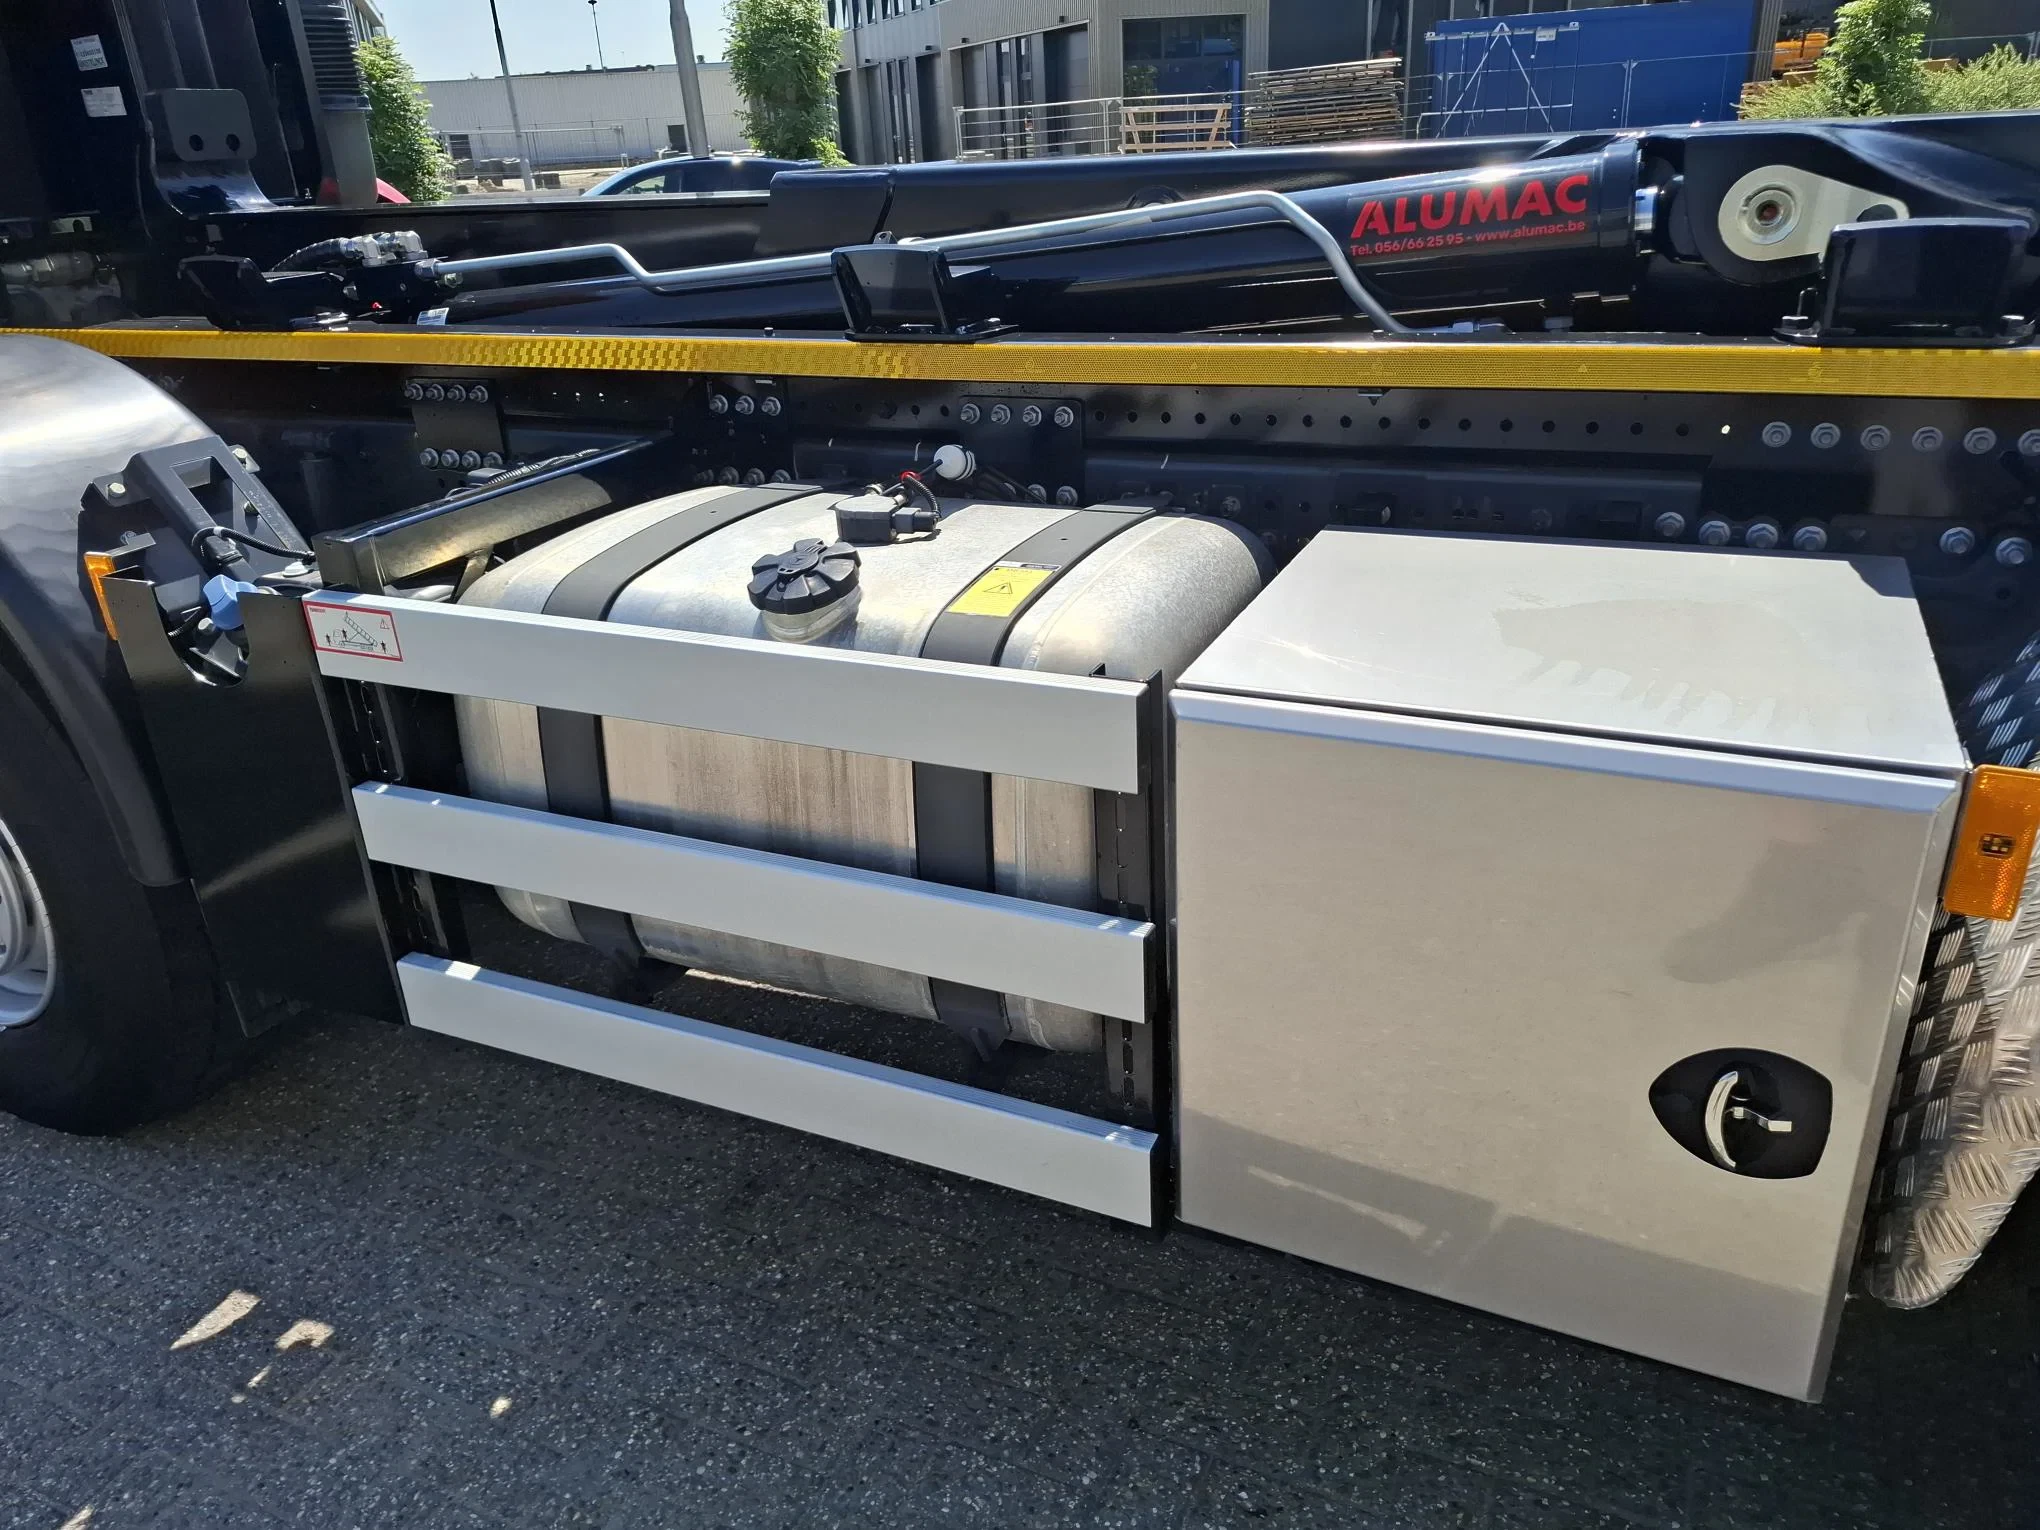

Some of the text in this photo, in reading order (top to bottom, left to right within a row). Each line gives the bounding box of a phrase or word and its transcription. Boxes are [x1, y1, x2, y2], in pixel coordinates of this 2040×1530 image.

[1350, 174, 1589, 239] ALUMAC
[1350, 243, 1373, 257] Tel.
[1375, 238, 1424, 254] 056/66
[1427, 235, 1444, 248] 25
[1446, 232, 1464, 246] 95
[1475, 219, 1586, 242] www.alumac.be
